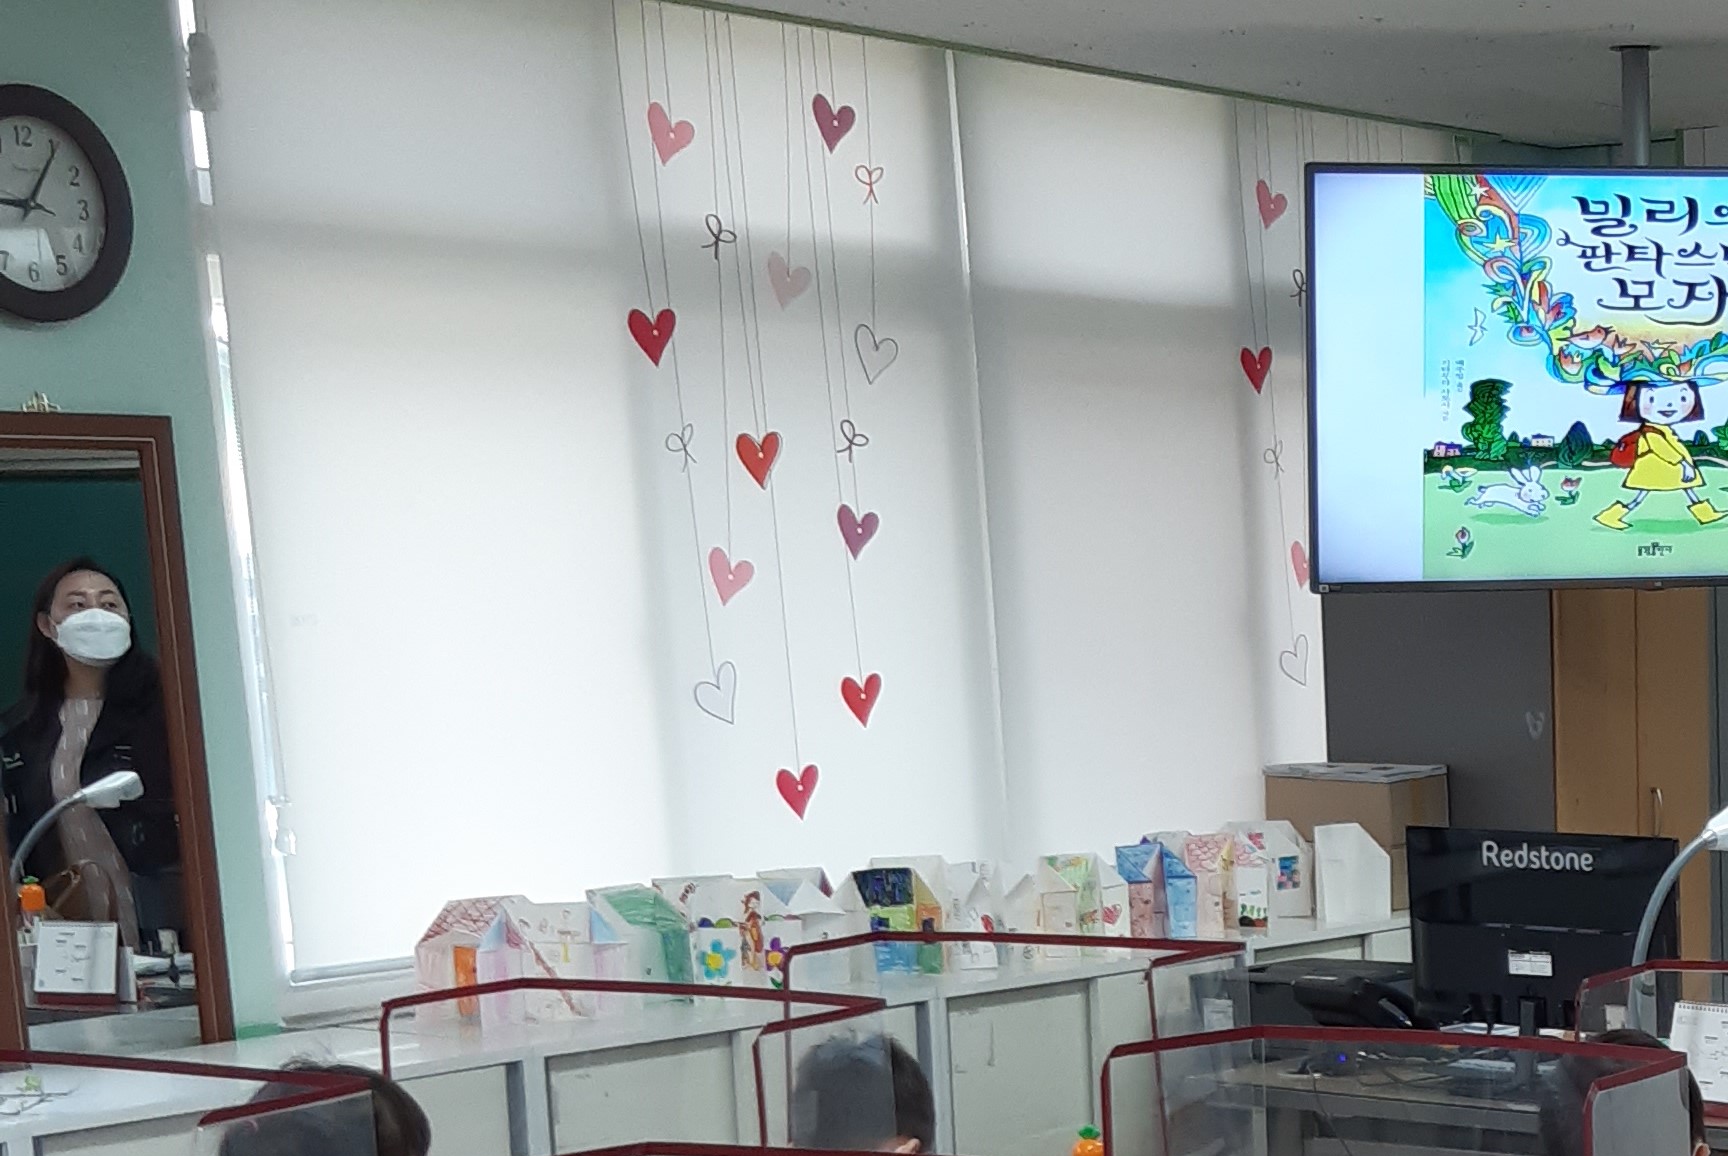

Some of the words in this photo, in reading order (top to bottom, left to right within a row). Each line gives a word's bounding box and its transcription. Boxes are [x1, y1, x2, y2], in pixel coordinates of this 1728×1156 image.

[13, 125, 33, 148] 12
[68, 165, 81, 187] 2
[78, 199, 90, 221] 3
[73, 233, 83, 253] 4
[28, 261, 40, 283] 6
[56, 255, 68, 276] 5
[1481, 840, 1594, 872] Redstone
